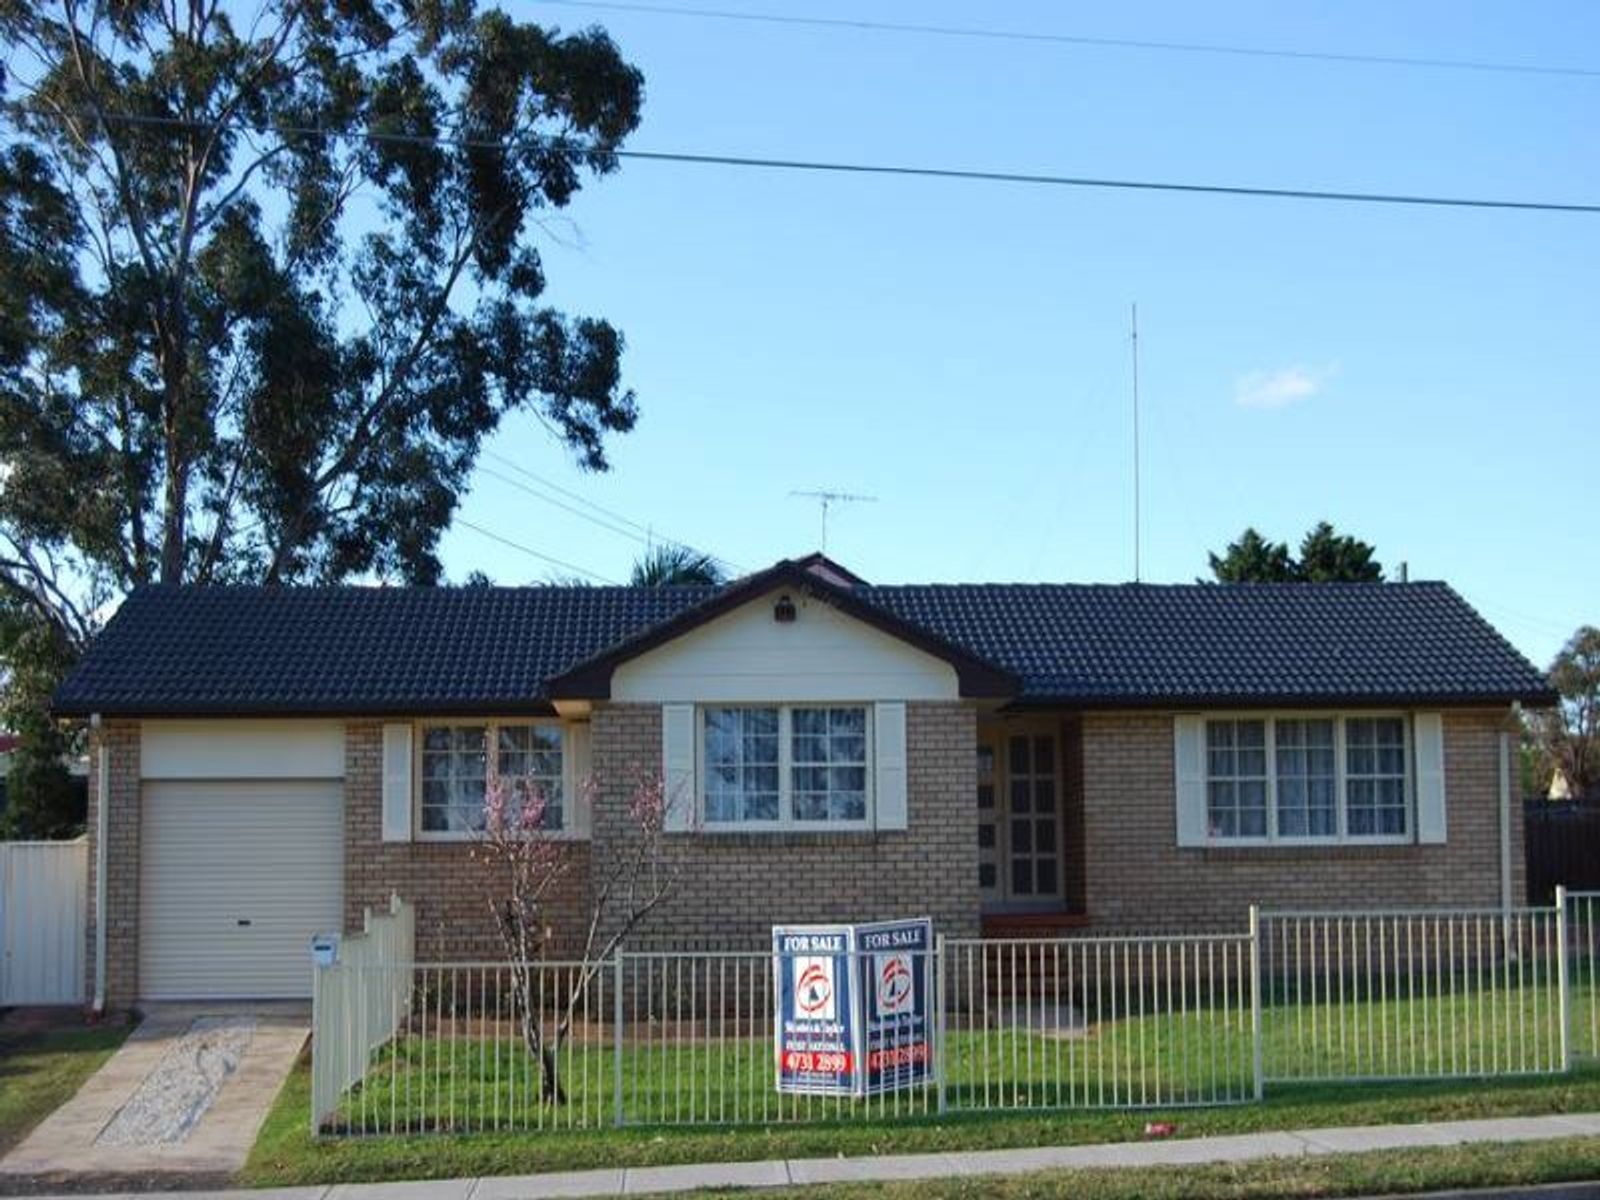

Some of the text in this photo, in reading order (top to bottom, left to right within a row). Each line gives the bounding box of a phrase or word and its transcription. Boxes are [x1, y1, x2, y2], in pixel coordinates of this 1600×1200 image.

[784, 936, 842, 950] FOR SALE
[865, 930, 920, 948] FOR SALE
